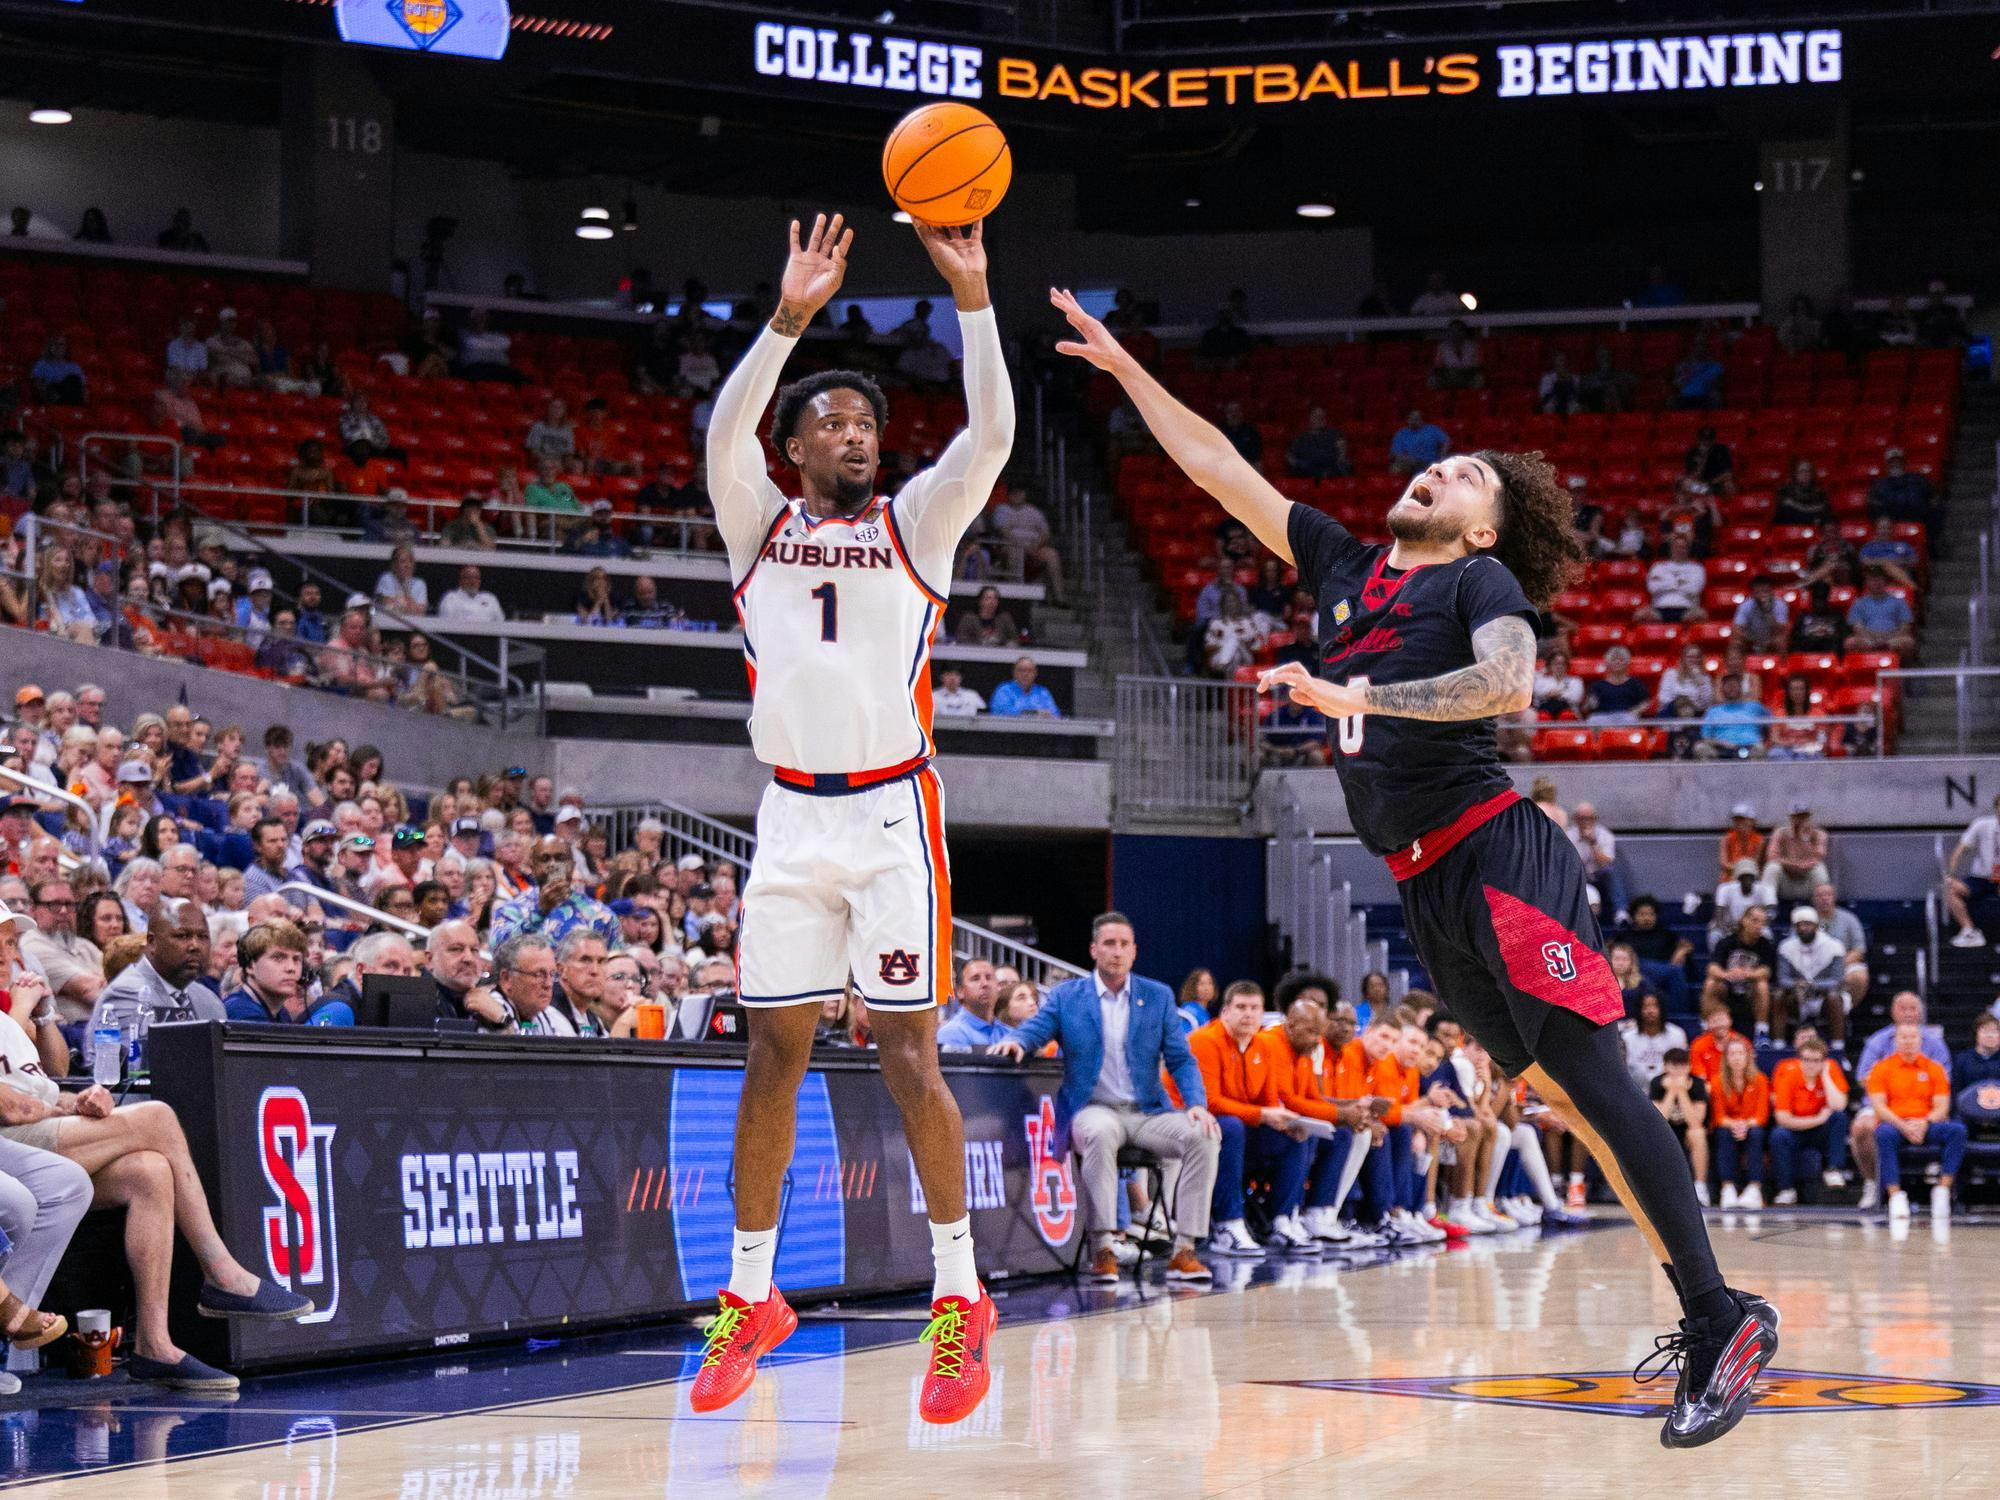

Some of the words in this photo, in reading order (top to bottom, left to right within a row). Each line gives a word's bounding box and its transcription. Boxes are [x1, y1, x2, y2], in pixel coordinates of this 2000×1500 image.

[755, 21, 983, 99] COLLEGE
[998, 53, 1480, 108] BASKETBALL'S
[1497, 29, 1842, 97] BEGINNING
[328, 116, 382, 152] 118
[1775, 159, 1830, 191] 117
[855, 526, 879, 543] SEC
[761, 541, 893, 569] AUBURN
[811, 581, 838, 643] 1
[1338, 675, 1371, 756] 0
[1945, 775, 1977, 809] N
[401, 1150, 583, 1249] SEATTLE
